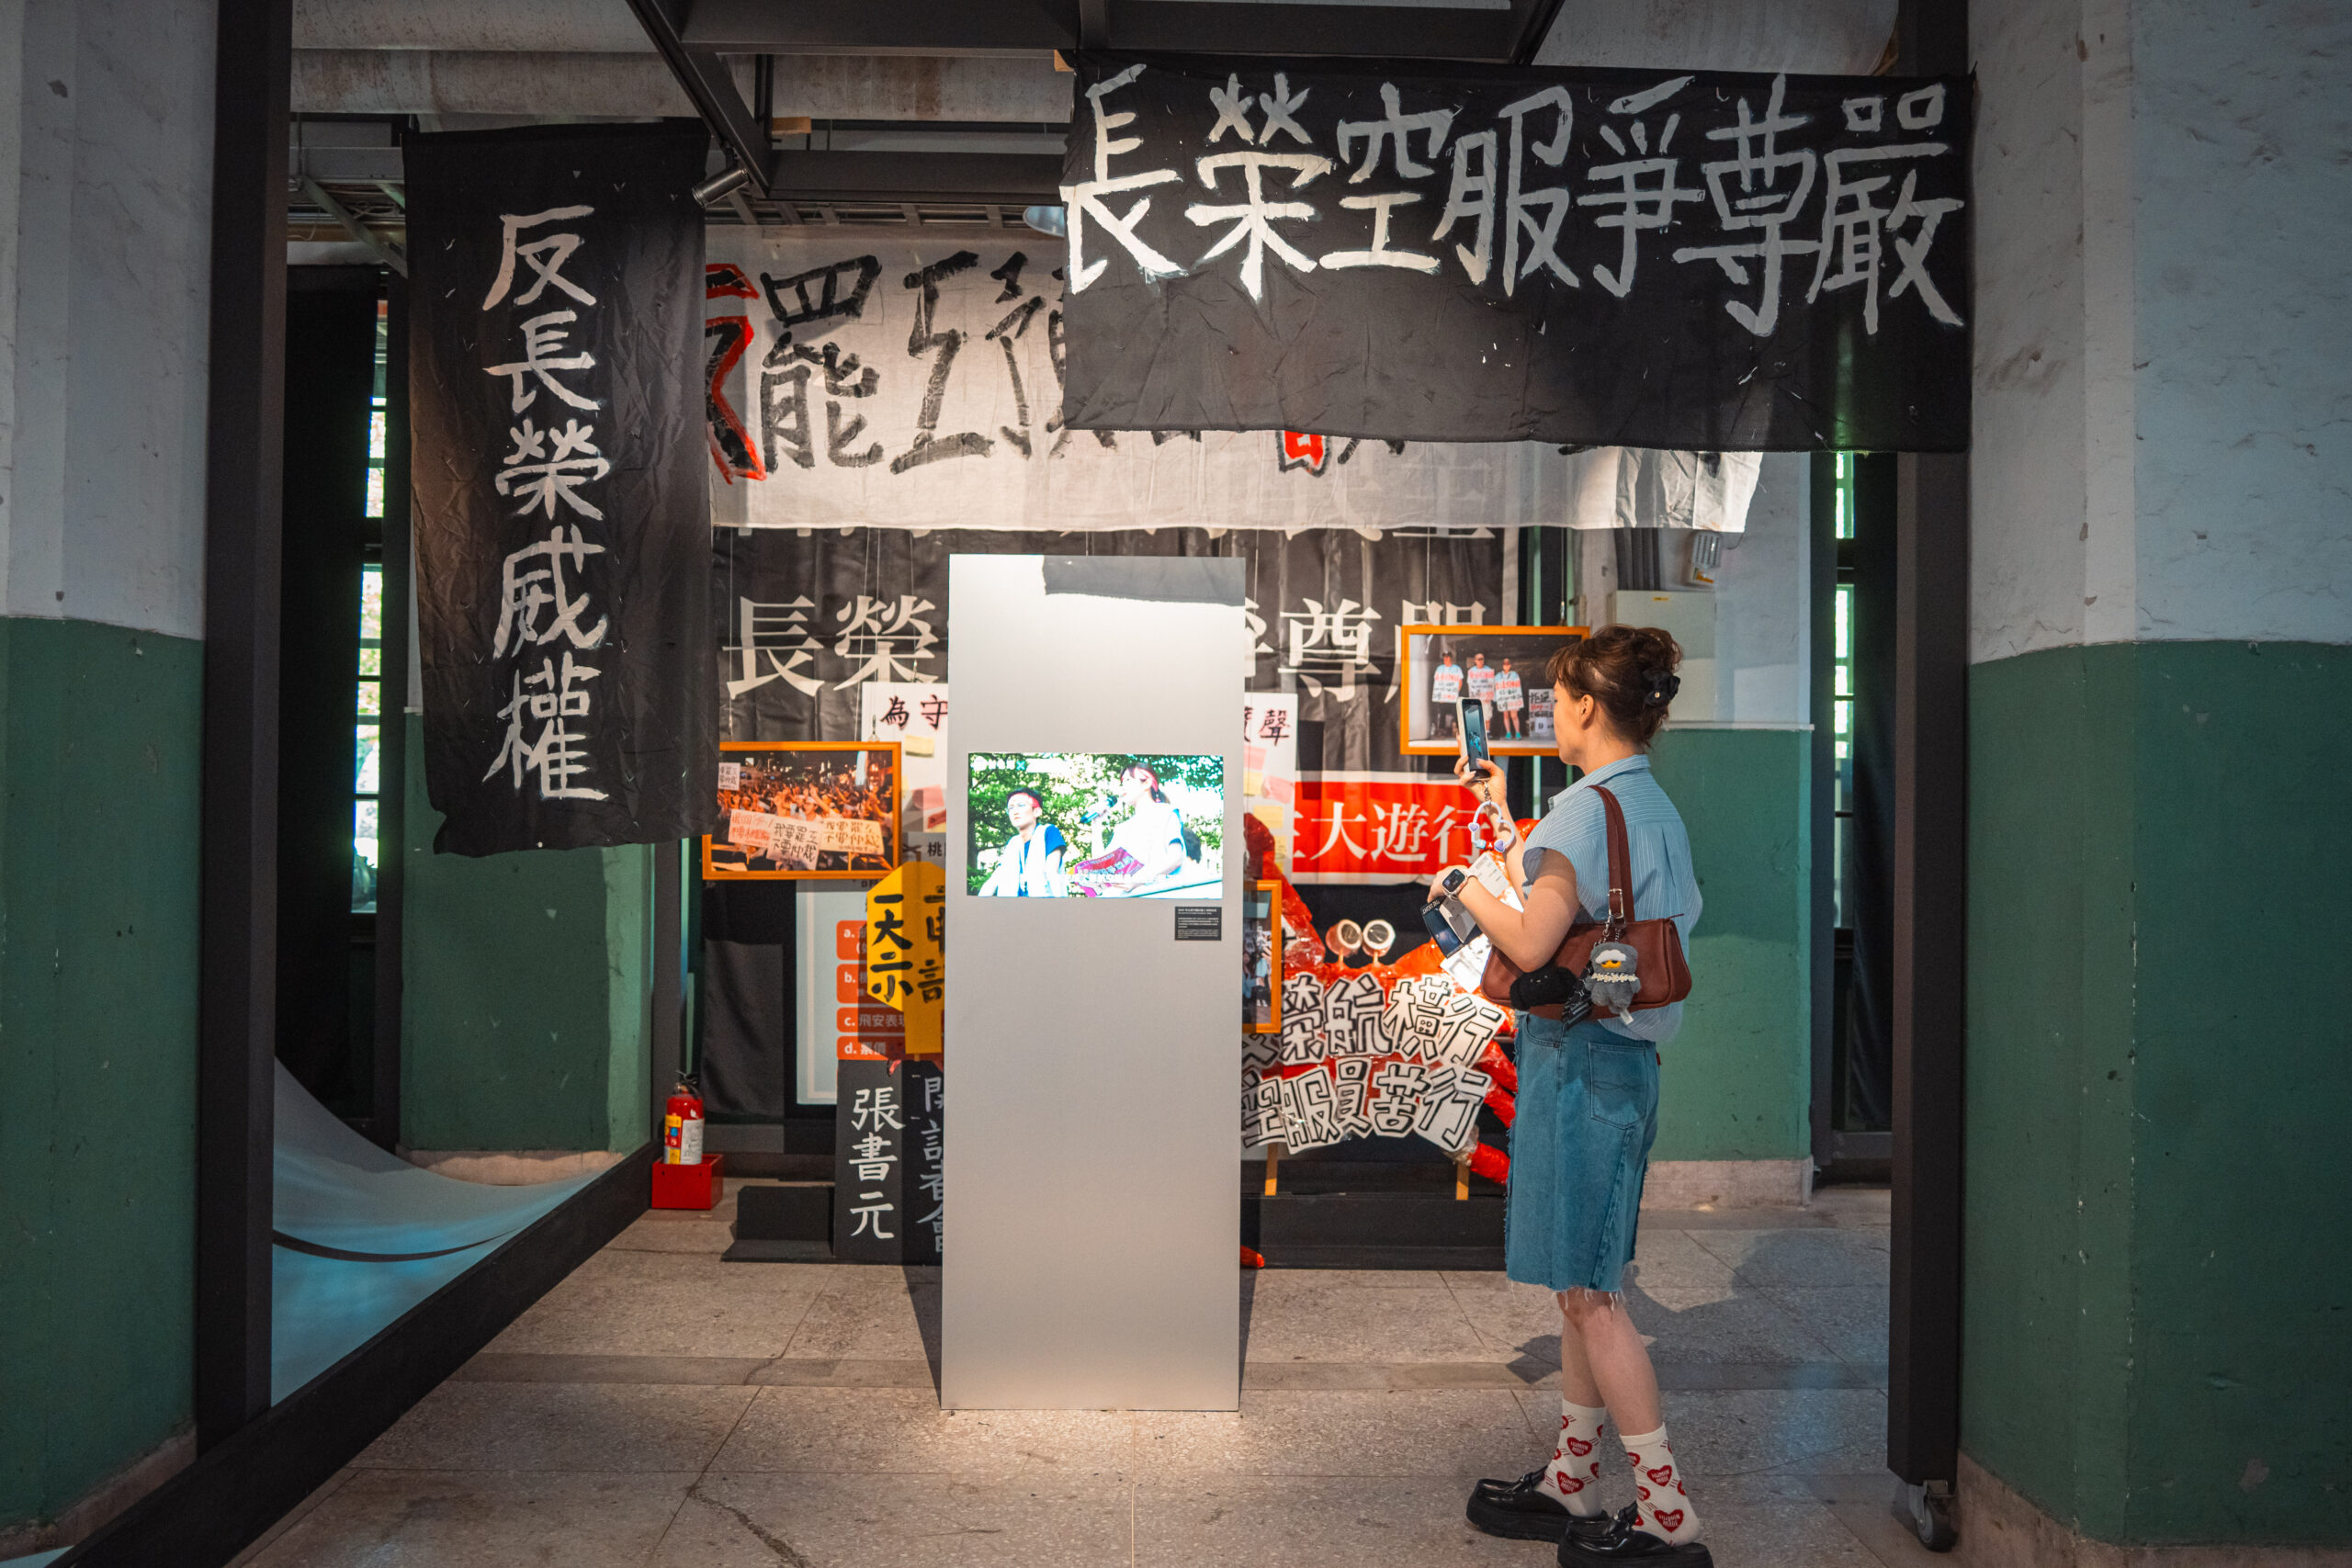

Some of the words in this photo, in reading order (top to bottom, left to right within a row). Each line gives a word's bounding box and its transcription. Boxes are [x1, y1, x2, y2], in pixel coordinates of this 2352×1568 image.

[1059, 62, 1965, 336] 長榮空服爭尊嚴
[482, 204, 610, 802] 反長榮威權
[848, 1086, 906, 1239] 張書元
